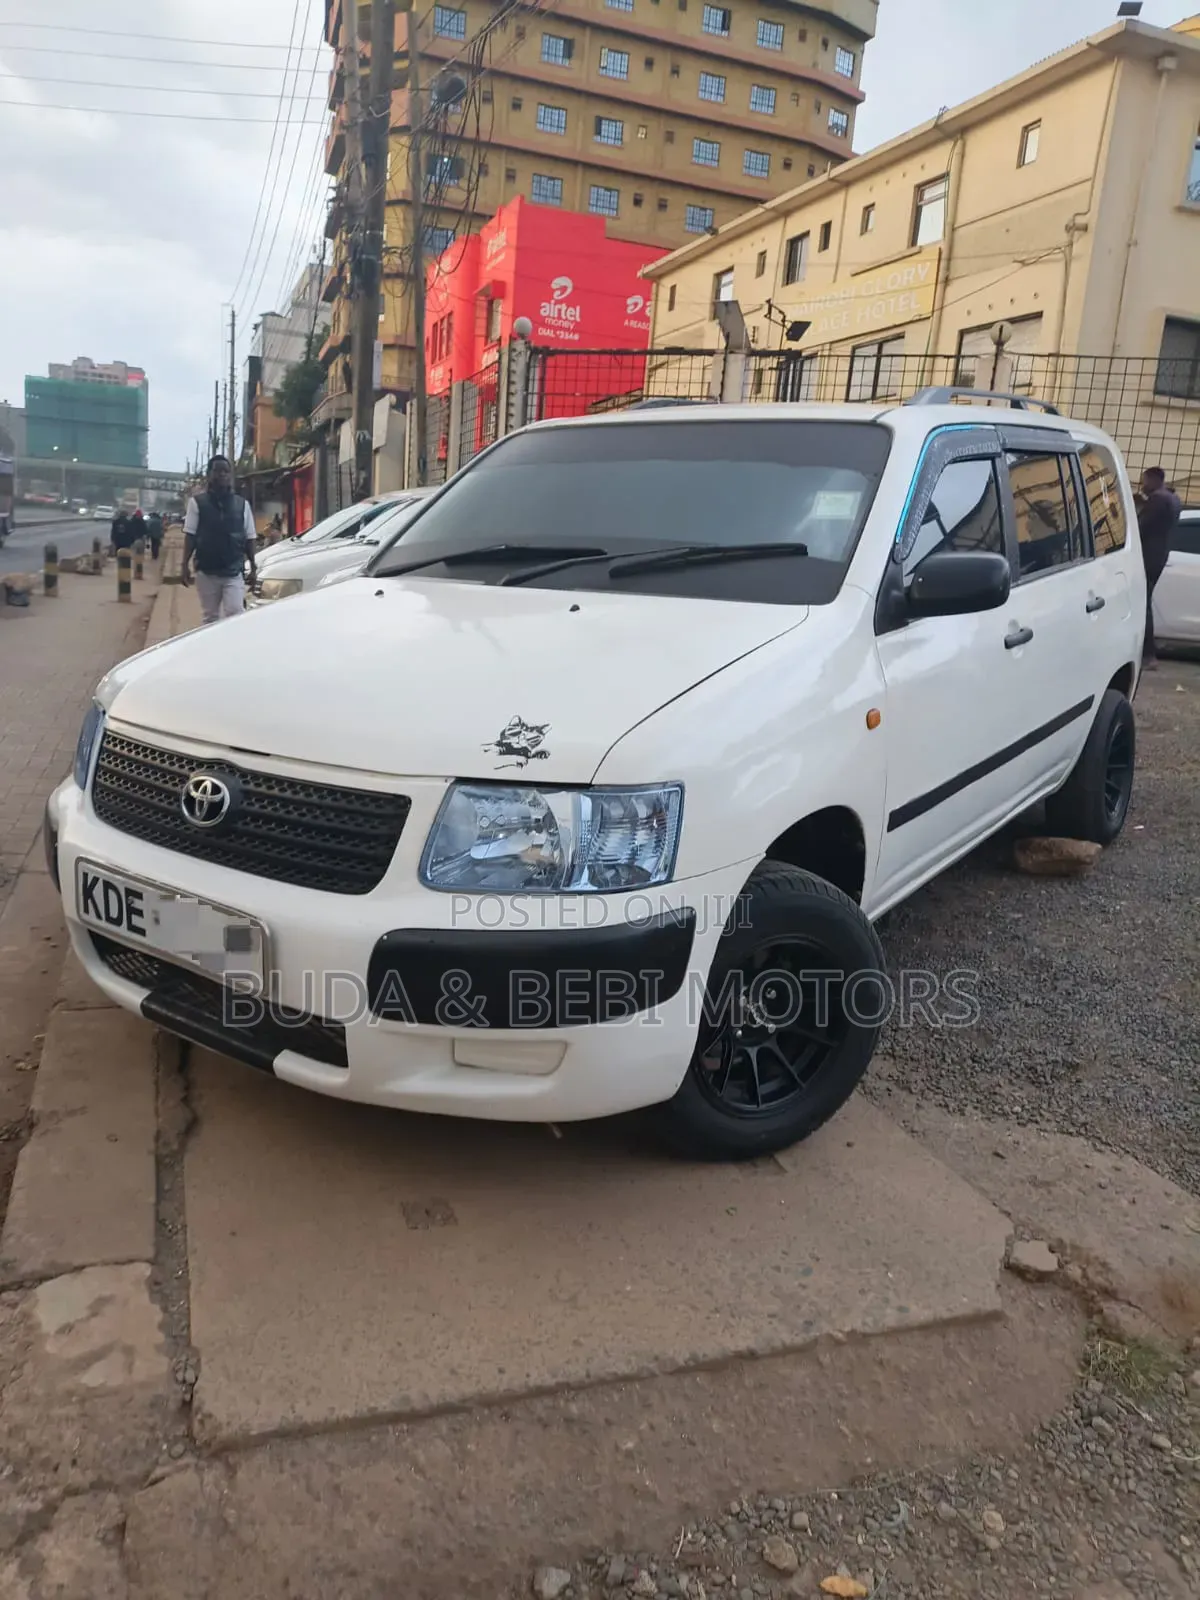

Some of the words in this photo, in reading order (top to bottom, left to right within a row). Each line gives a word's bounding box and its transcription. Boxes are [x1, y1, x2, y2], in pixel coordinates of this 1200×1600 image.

[861, 262, 931, 296] GLORY
[540, 300, 581, 322] airtel
[857, 291, 921, 324] HOTEL
[545, 317, 575, 332] money
[82, 872, 147, 936] KDE
